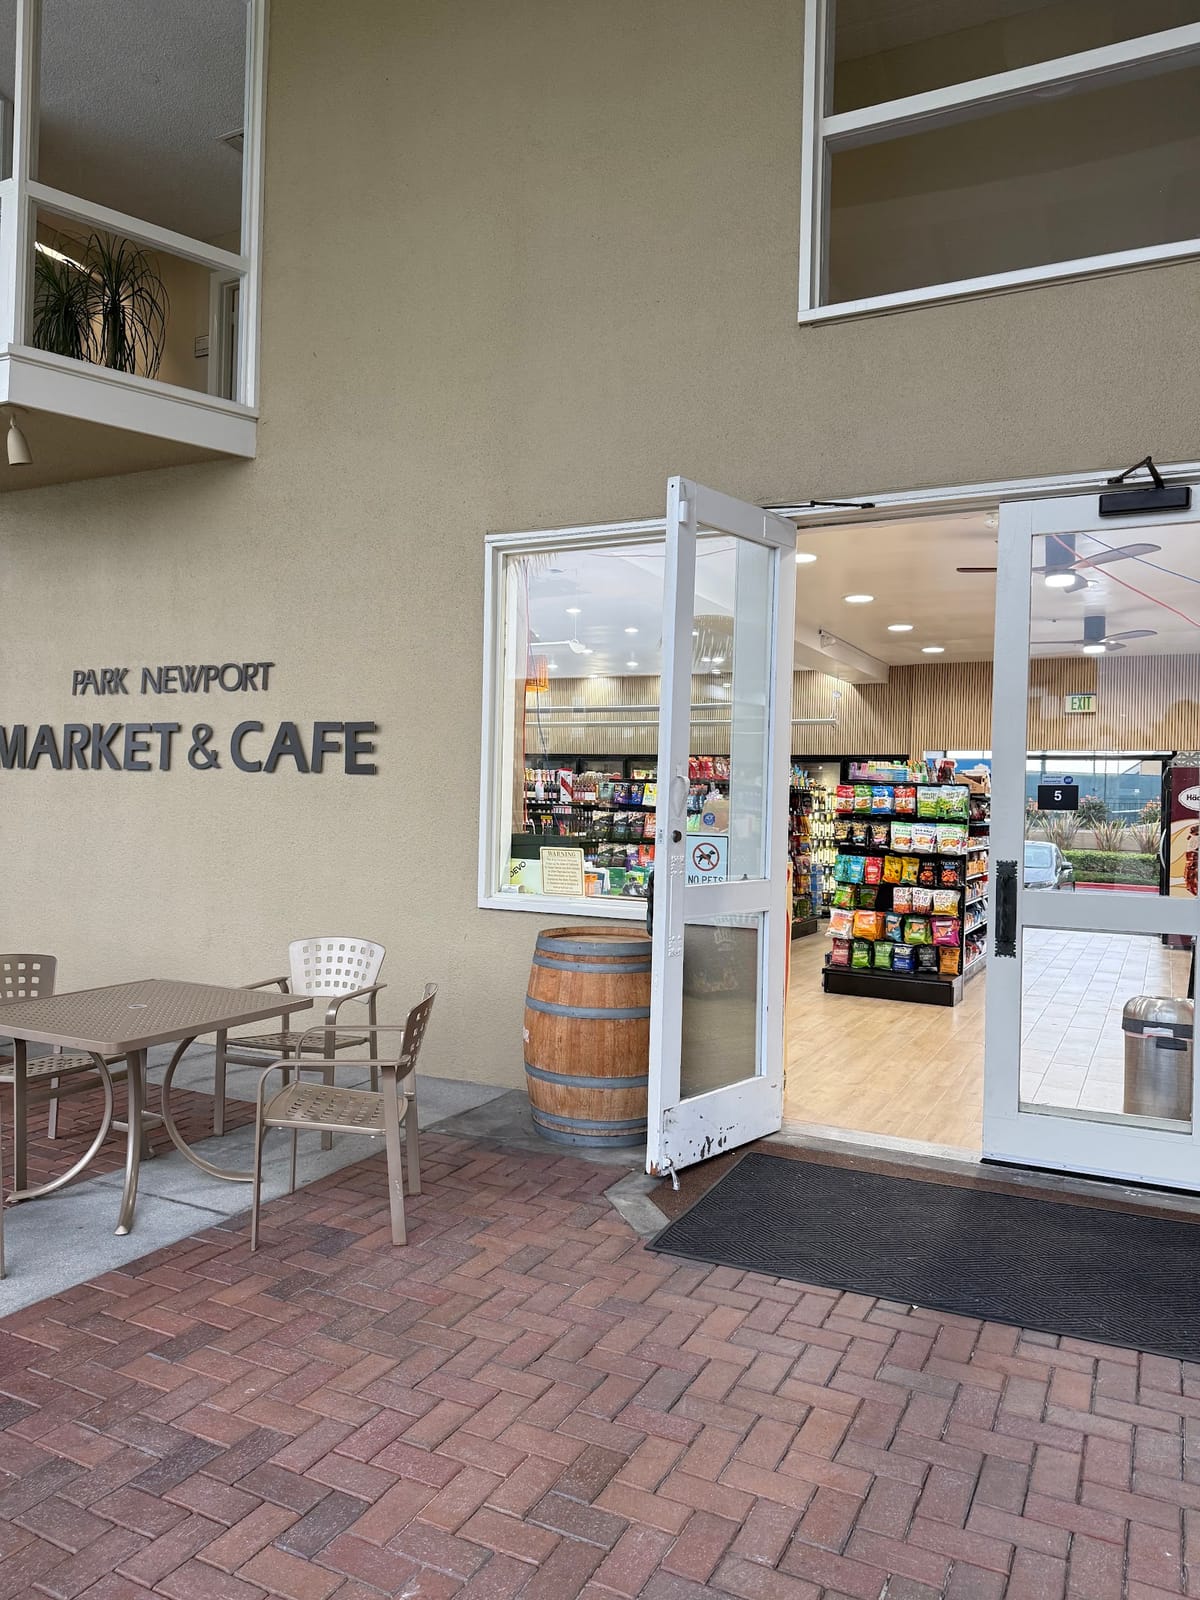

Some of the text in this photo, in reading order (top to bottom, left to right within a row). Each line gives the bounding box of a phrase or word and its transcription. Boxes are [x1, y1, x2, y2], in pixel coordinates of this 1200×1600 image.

[71, 661, 275, 695] PARK NEWPORT
[1071, 696, 1092, 710] EXIT
[0, 720, 377, 775] MARKET & CAFE
[1054, 790, 1062, 801] 5
[547, 850, 577, 858] WARNING
[688, 875, 699, 884] NO
